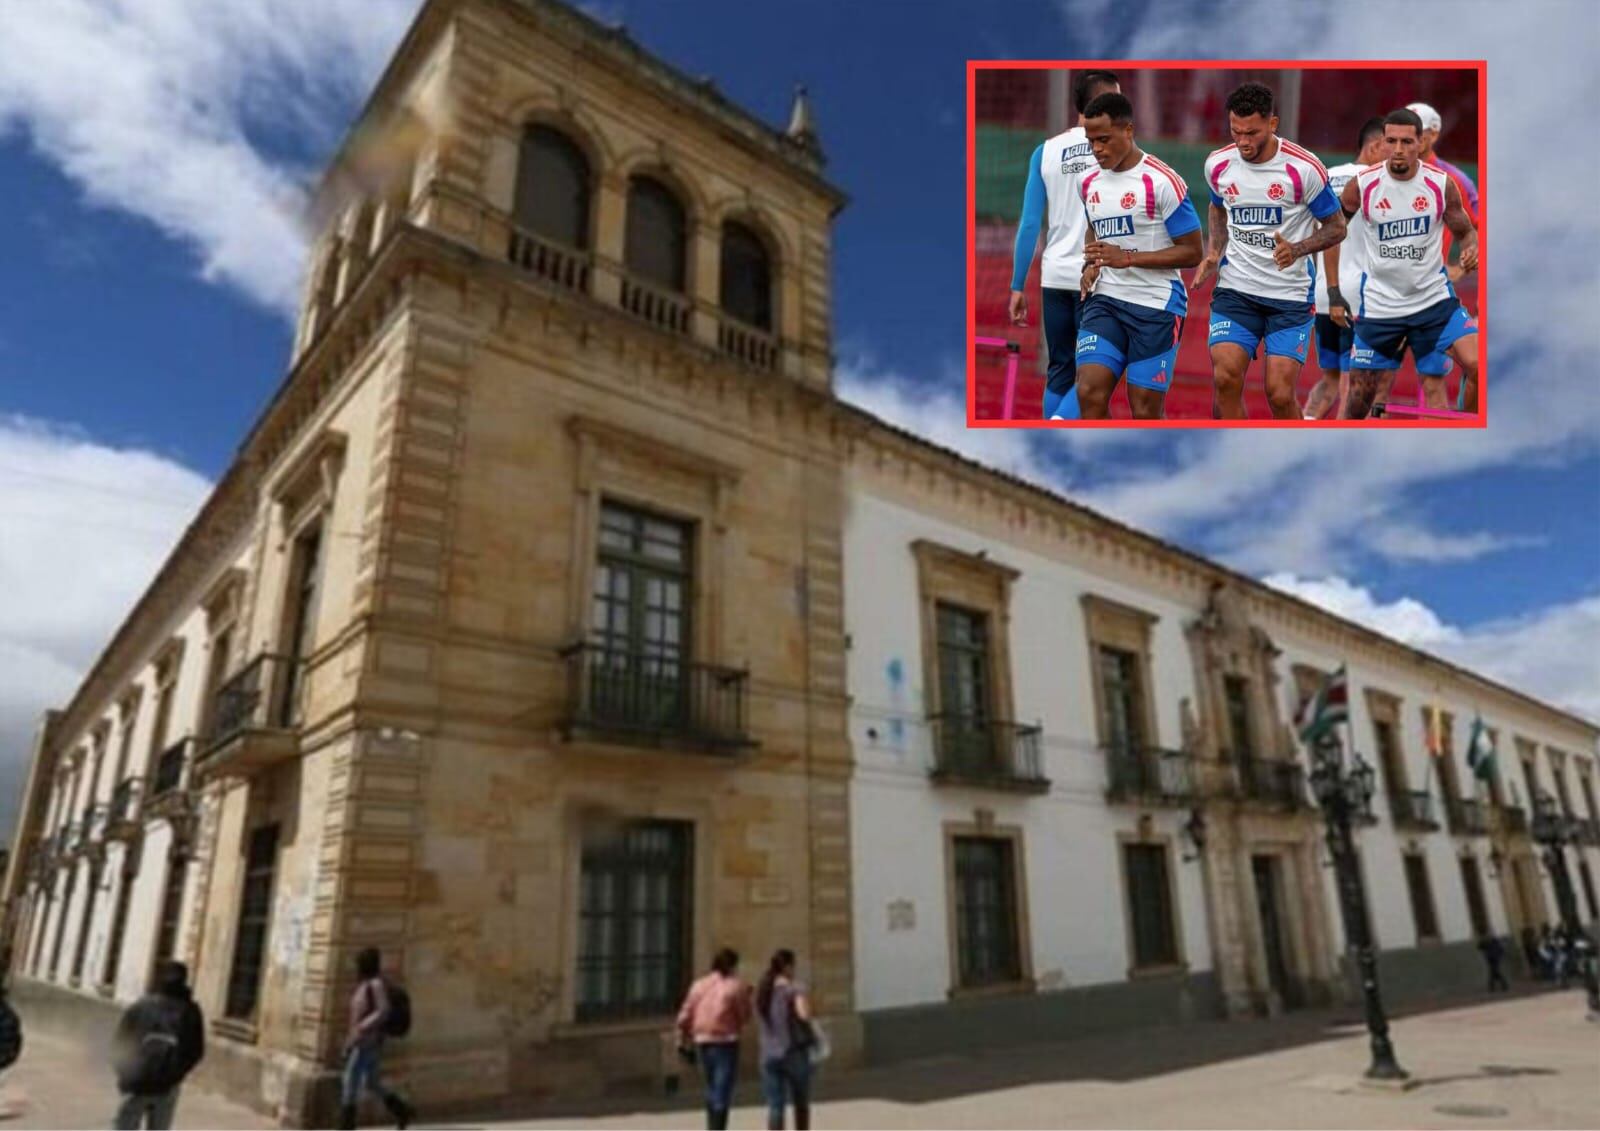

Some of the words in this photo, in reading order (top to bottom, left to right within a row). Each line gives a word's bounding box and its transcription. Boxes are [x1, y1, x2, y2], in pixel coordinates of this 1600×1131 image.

[1063, 143, 1093, 160] AGUIL
[1234, 207, 1279, 224] AGUILA
[1382, 217, 1426, 240] AGUILA
[1380, 244, 1427, 261] BetPlay
